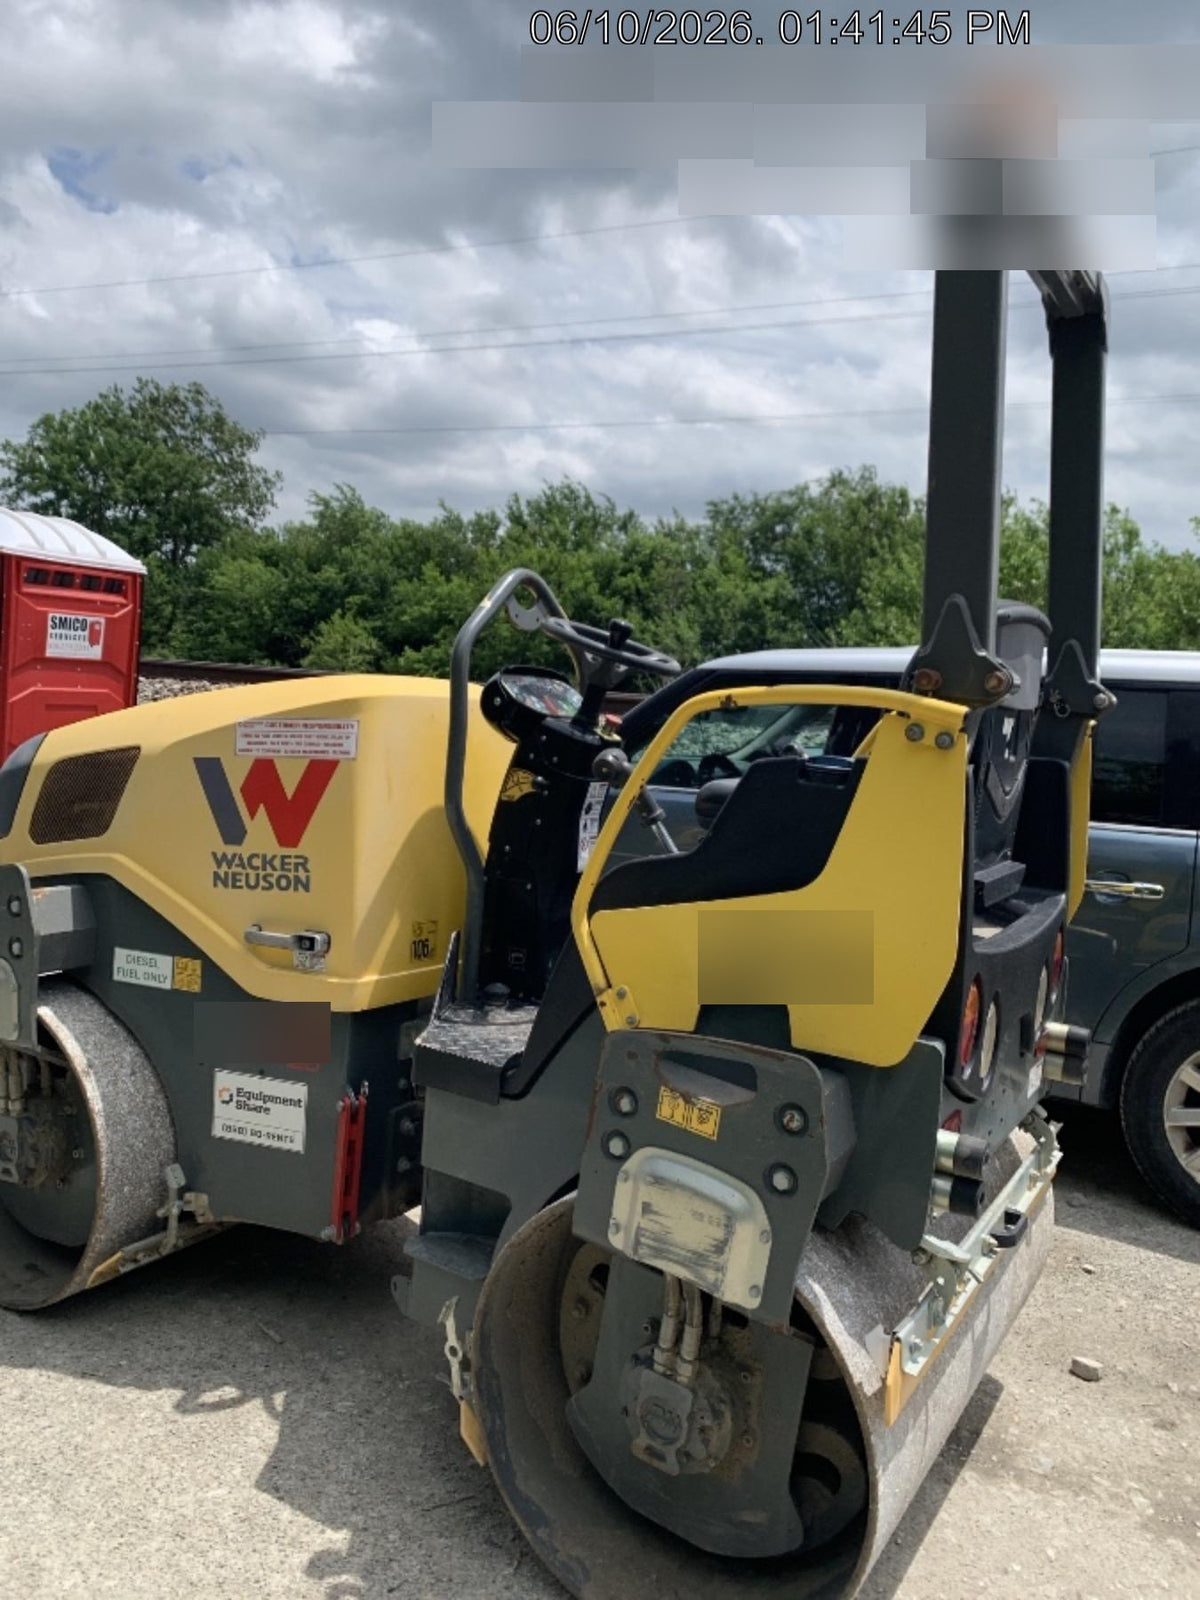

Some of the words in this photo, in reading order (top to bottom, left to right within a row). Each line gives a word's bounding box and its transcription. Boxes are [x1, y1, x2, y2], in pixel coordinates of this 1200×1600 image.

[50, 615, 88, 632] SMICO
[211, 851, 311, 873] WACKER
[212, 871, 311, 893] NEUSON
[126, 954, 158, 968] DIESEL
[117, 966, 141, 980] FUEL
[143, 971, 168, 984] ONLY
[236, 1087, 303, 1108] Equipment
[235, 1099, 271, 1115] Share
